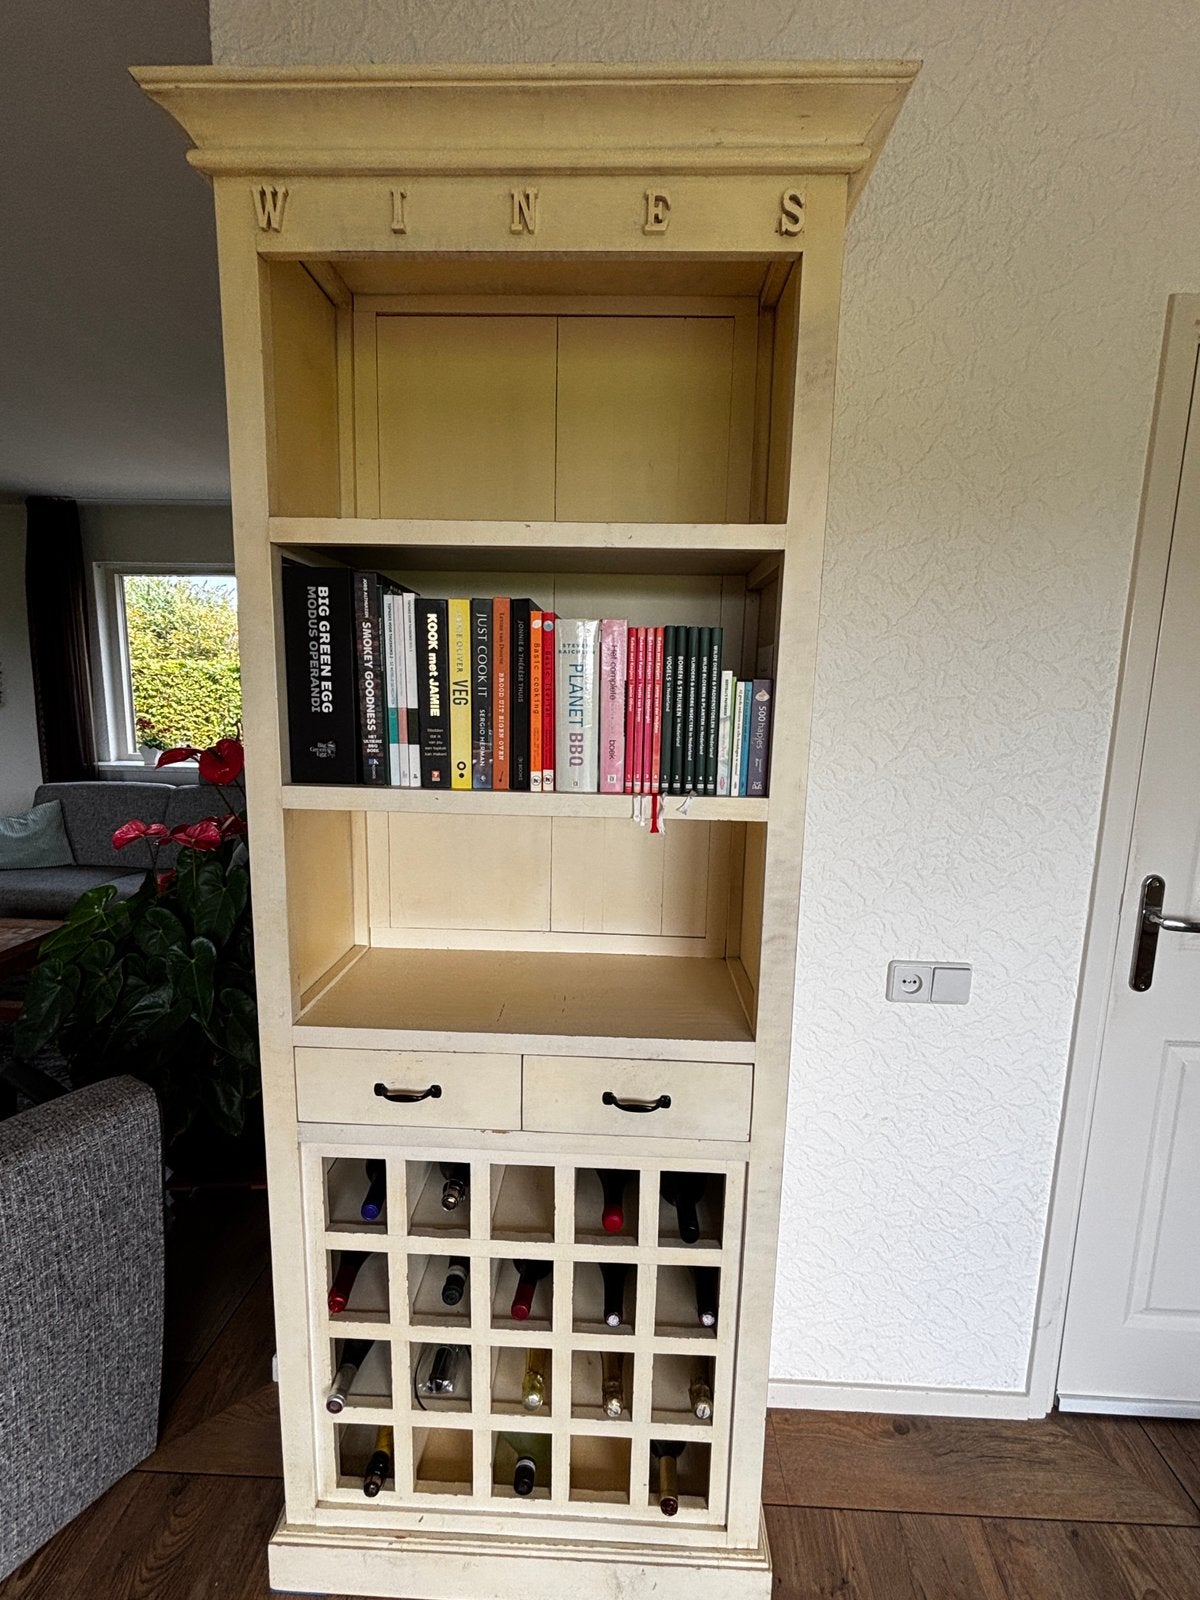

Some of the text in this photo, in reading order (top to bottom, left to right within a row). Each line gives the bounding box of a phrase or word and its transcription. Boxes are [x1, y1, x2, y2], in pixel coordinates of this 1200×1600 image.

[250, 184, 806, 236] WINES
[307, 586, 320, 713] MODUS OPERANDI
[318, 586, 333, 713] BIG GREEN EGG
[427, 613, 441, 717] KOOK met JAMIE
[456, 641, 464, 672] OLIVER
[476, 612, 488, 698] JUST COOK IT
[610, 644, 618, 659] Het
[362, 621, 376, 731] SMOKEY GOODNESS
[452, 680, 469, 706] VEG
[532, 676, 540, 715] cooking
[609, 661, 617, 700] complete
[568, 663, 584, 767] PLANET BBQ
[758, 706, 767, 721] 500
[609, 739, 617, 759] boek
[753, 722, 765, 749] hapjes
